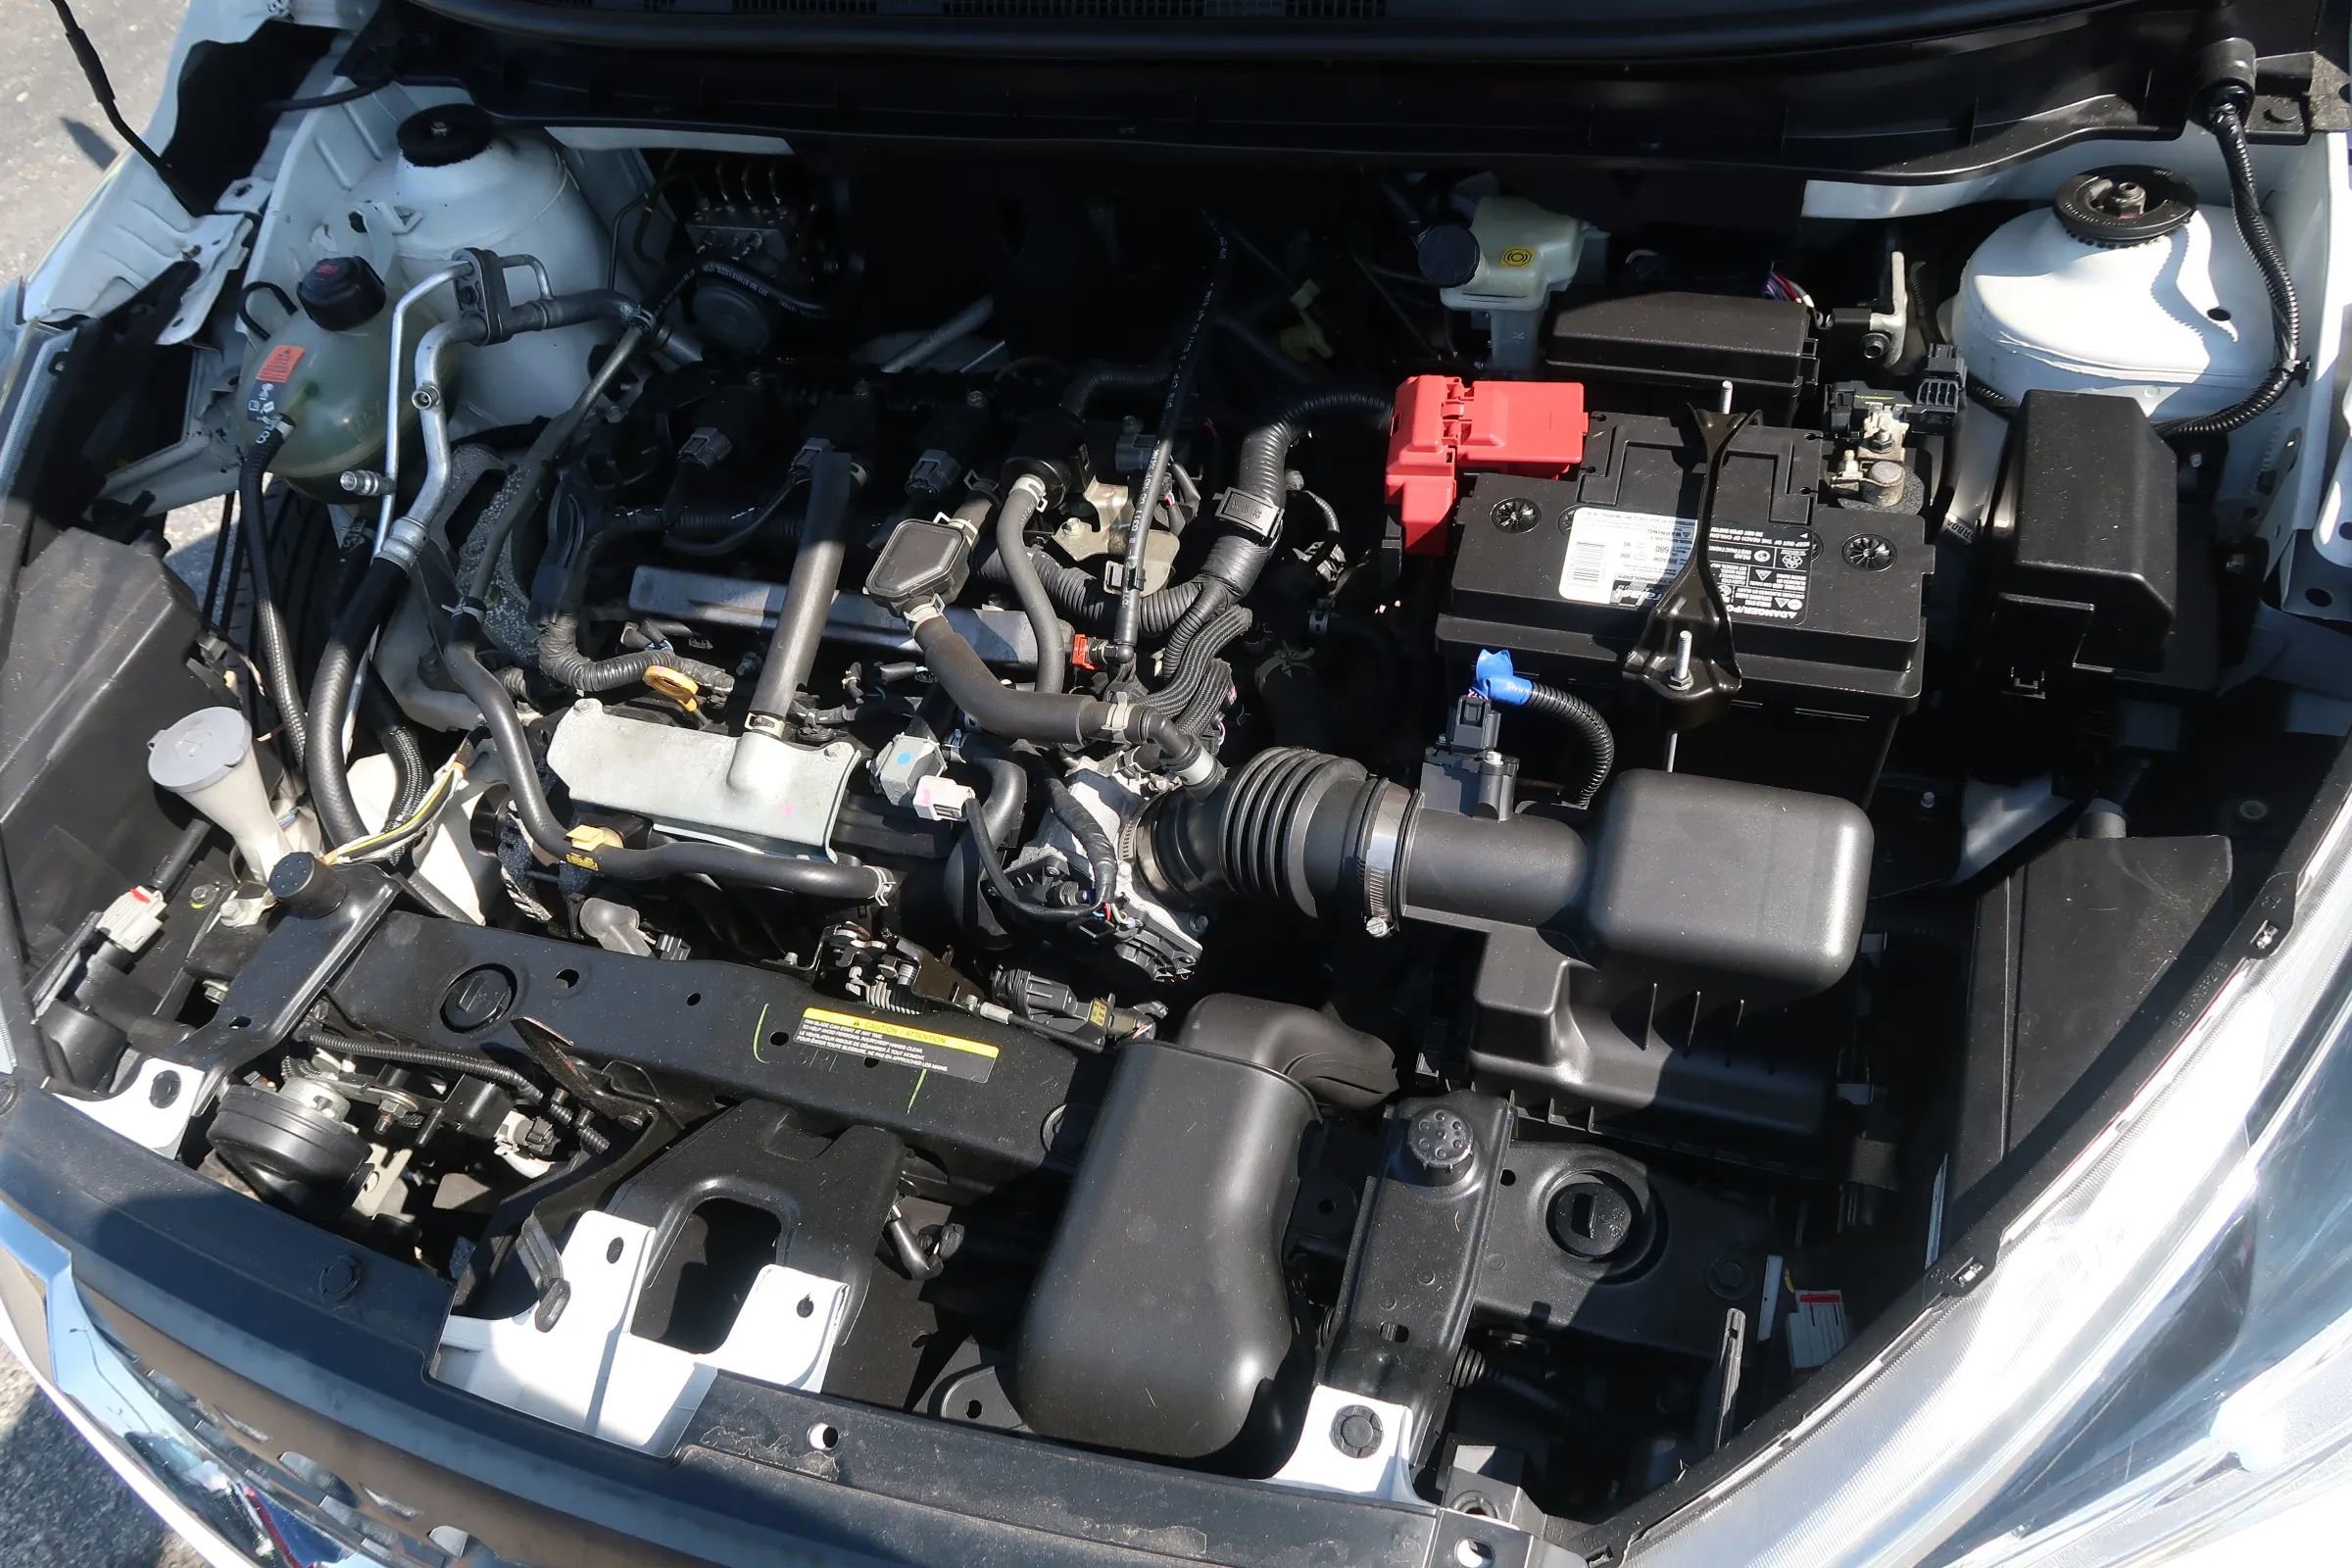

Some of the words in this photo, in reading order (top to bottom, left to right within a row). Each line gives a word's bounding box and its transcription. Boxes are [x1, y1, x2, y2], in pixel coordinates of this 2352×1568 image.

[1726, 605, 1788, 618] DANGER/PO
[835, 1031, 860, 1041] PERSONAL
[889, 1042, 906, 1051] HANDS
[864, 1022, 898, 1034] CAUTION
[906, 1031, 947, 1043] ATTENTION
[809, 1038, 827, 1047] ÉVITER
[892, 1055, 923, 1066] APPROCHER
[835, 1037, 853, 1046] RISQUE
[860, 1043, 886, 1053] DÉMARRER
